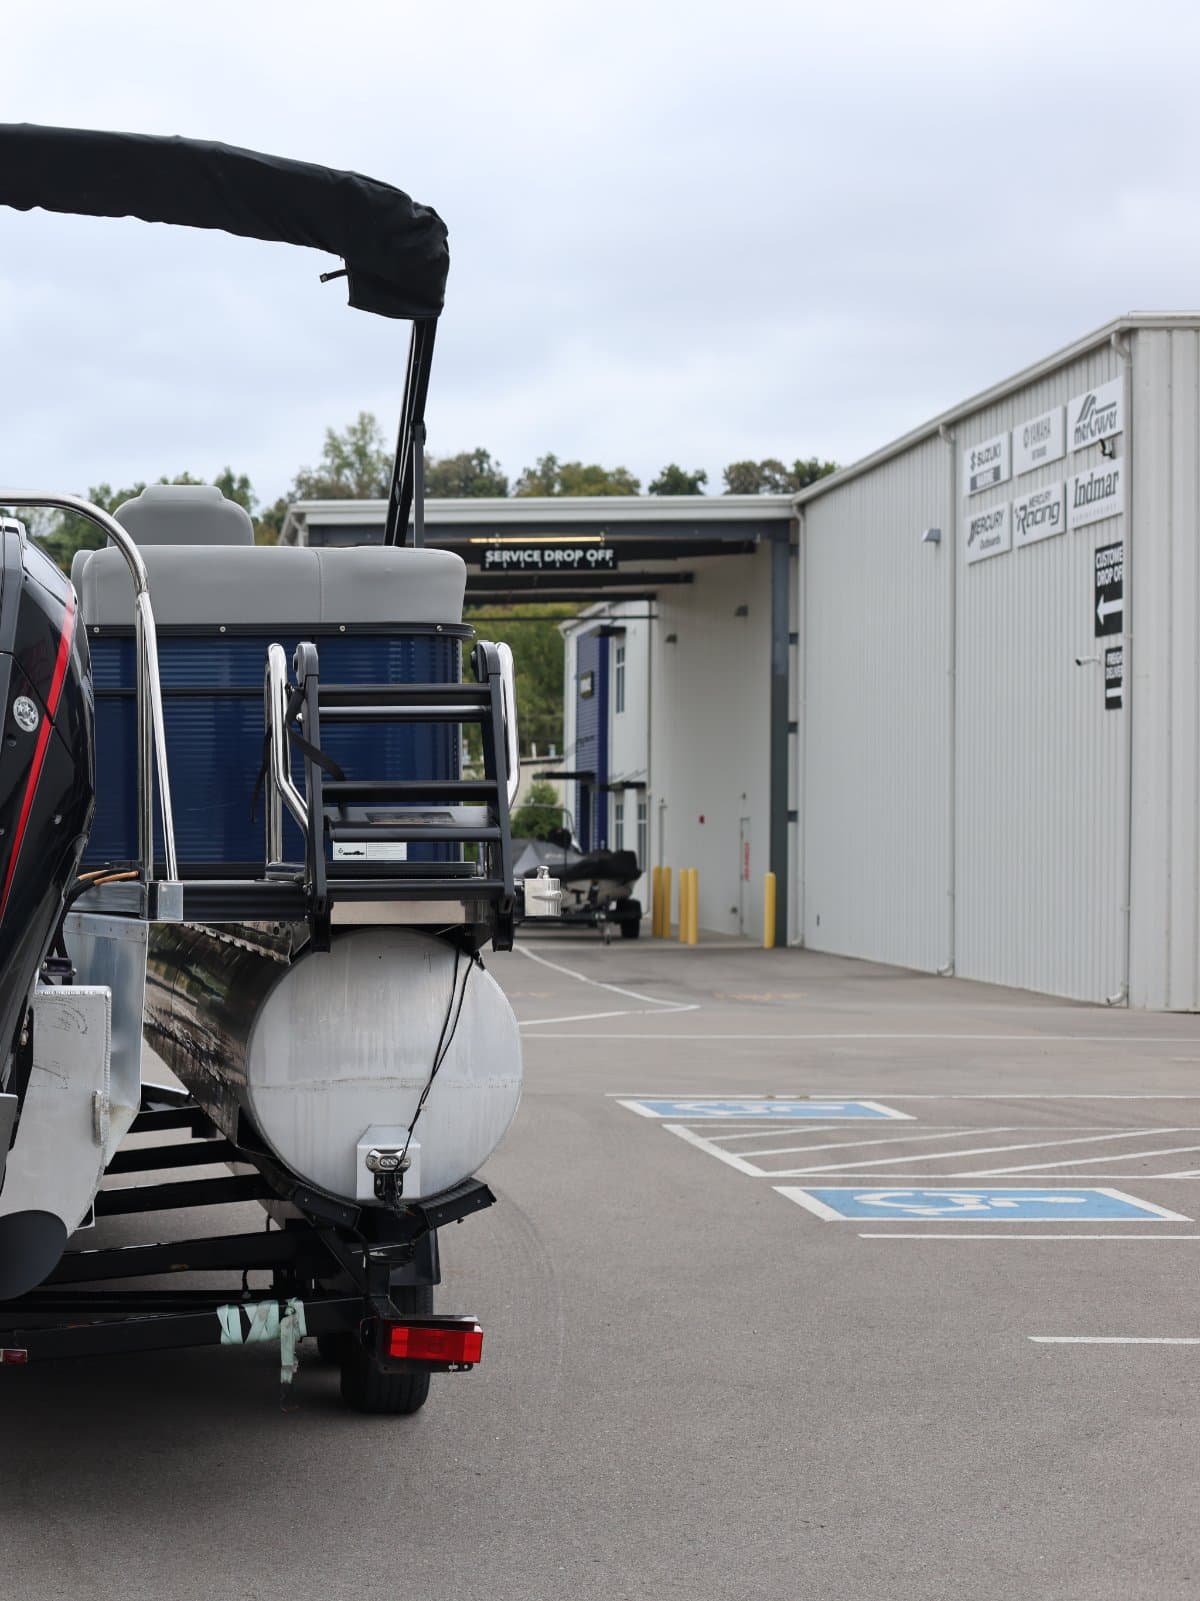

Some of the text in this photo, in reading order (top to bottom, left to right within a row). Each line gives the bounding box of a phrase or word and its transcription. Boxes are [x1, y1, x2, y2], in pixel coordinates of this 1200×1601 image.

[977, 442, 1000, 467] SUZUKI
[1073, 470, 1119, 509] Indmar
[968, 509, 1005, 547] MERCURY
[1015, 501, 1060, 535] Racing
[485, 549, 614, 562] SERVICE DROP OFF
[1097, 568, 1114, 587] DROP
